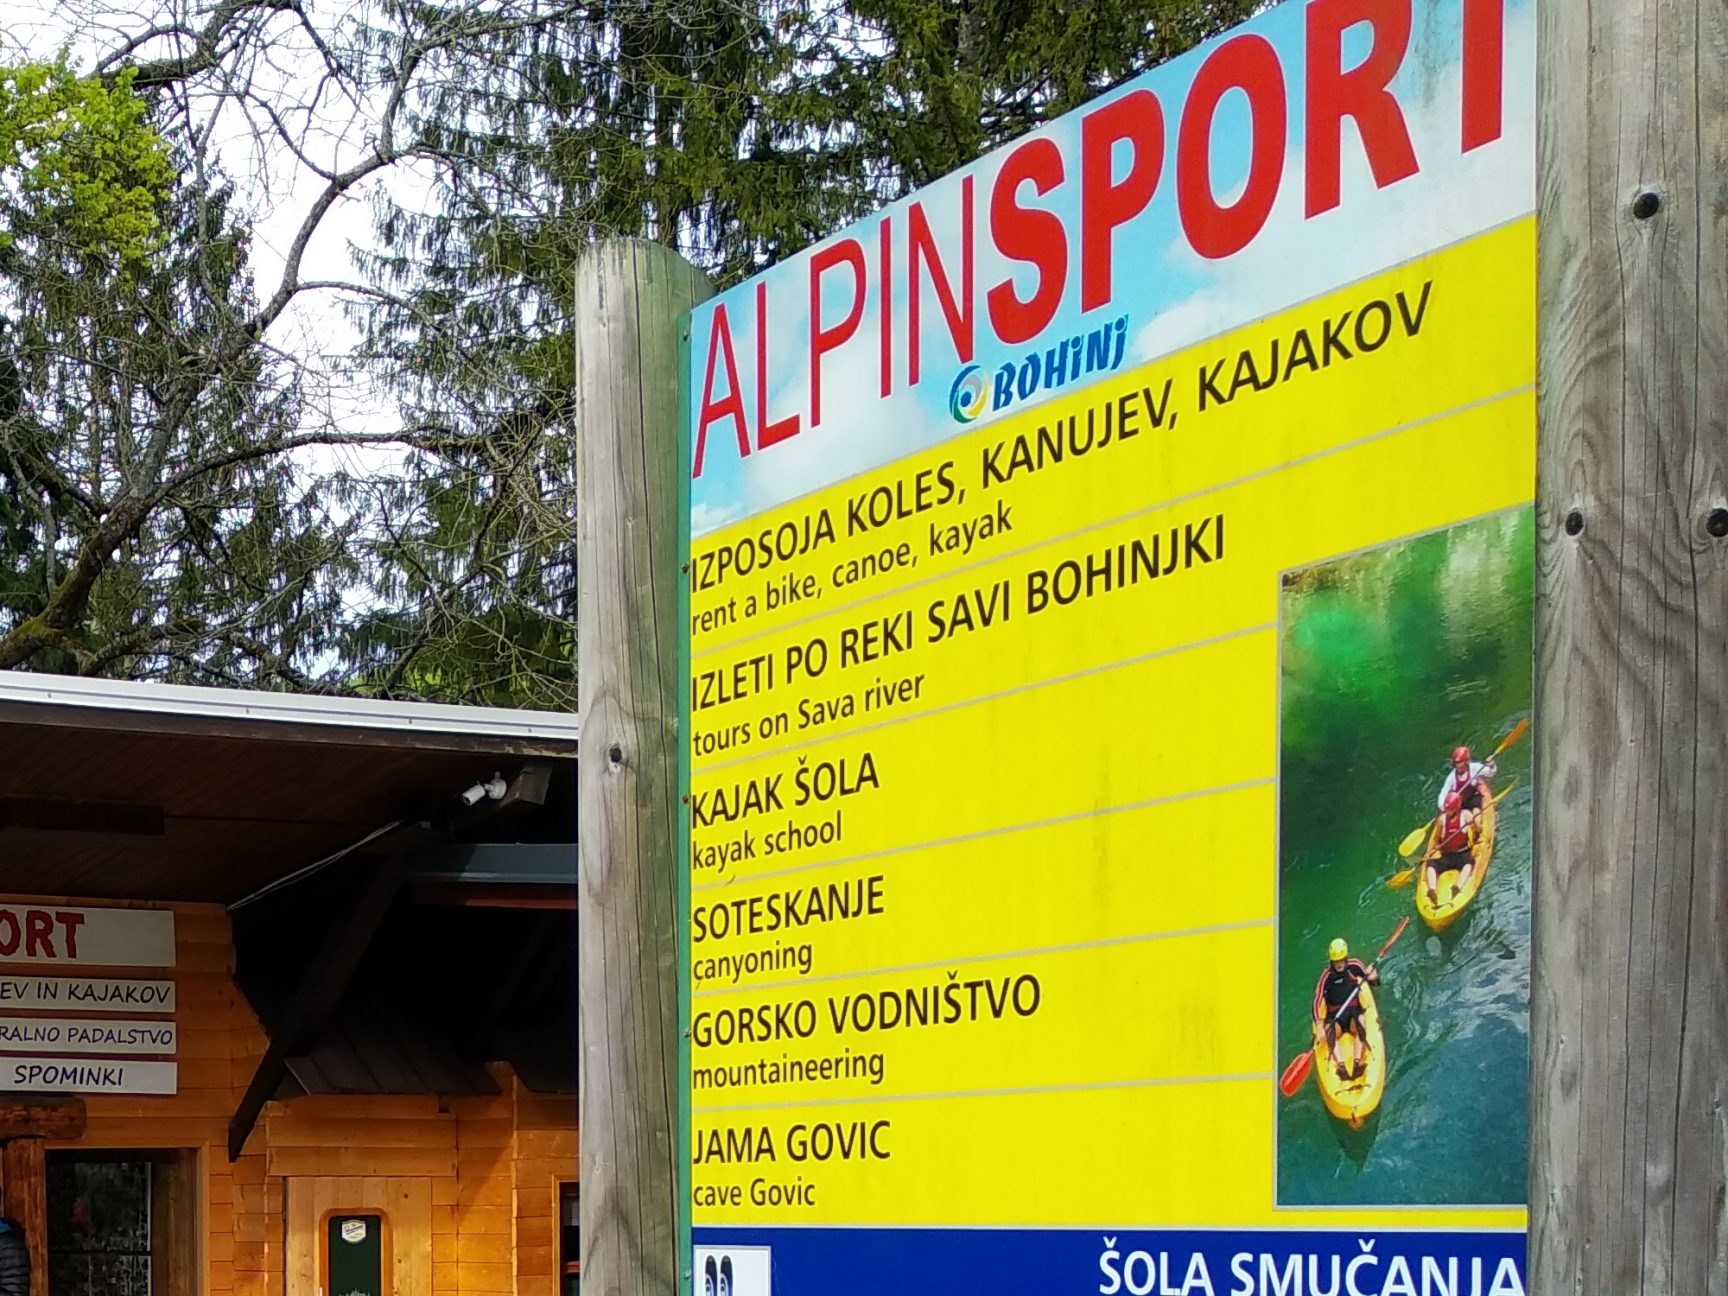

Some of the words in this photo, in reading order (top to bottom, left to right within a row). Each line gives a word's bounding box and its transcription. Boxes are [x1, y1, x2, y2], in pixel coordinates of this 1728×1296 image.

[691, 508, 836, 593] IZPOSOJA
[847, 461, 966, 537] KOLES,
[981, 379, 1181, 489] KANUJEV,
[1198, 281, 1435, 416] KAJAKOV
[692, 600, 737, 636] rent
[745, 595, 758, 619] a
[766, 571, 823, 611] bike,
[832, 545, 919, 588] canoe,
[929, 499, 1013, 558] kayak
[691, 653, 775, 712] IZLETI
[785, 638, 828, 686] PO
[840, 609, 913, 666] REKI
[927, 580, 1011, 643] SAVI
[1026, 513, 1227, 615] BOHINJKI
[692, 717, 751, 757] tours
[759, 711, 789, 740] on
[797, 691, 854, 730] Sava
[865, 671, 926, 712] river
[692, 773, 785, 830] KAJAK
[794, 751, 880, 807] ŠOLA
[692, 830, 756, 873] kayak
[764, 809, 843, 856] school
[692, 875, 885, 944] SOTESKANJE
[37, 982, 58, 1001] IN
[68, 983, 170, 1004] KAJAKOV
[693, 940, 813, 985] canyoning
[68, 1027, 173, 1046] PADALSTVO
[692, 999, 817, 1048] GORSKO
[829, 970, 1042, 1035] VODNIŠTVO
[14, 1065, 123, 1086] SPOMINKI
[693, 1047, 885, 1089] mountaineering
[693, 1126, 776, 1165] JAMA
[786, 1120, 891, 1162] GOVIC
[693, 1181, 743, 1207] cave
[750, 1176, 816, 1207] Govic
